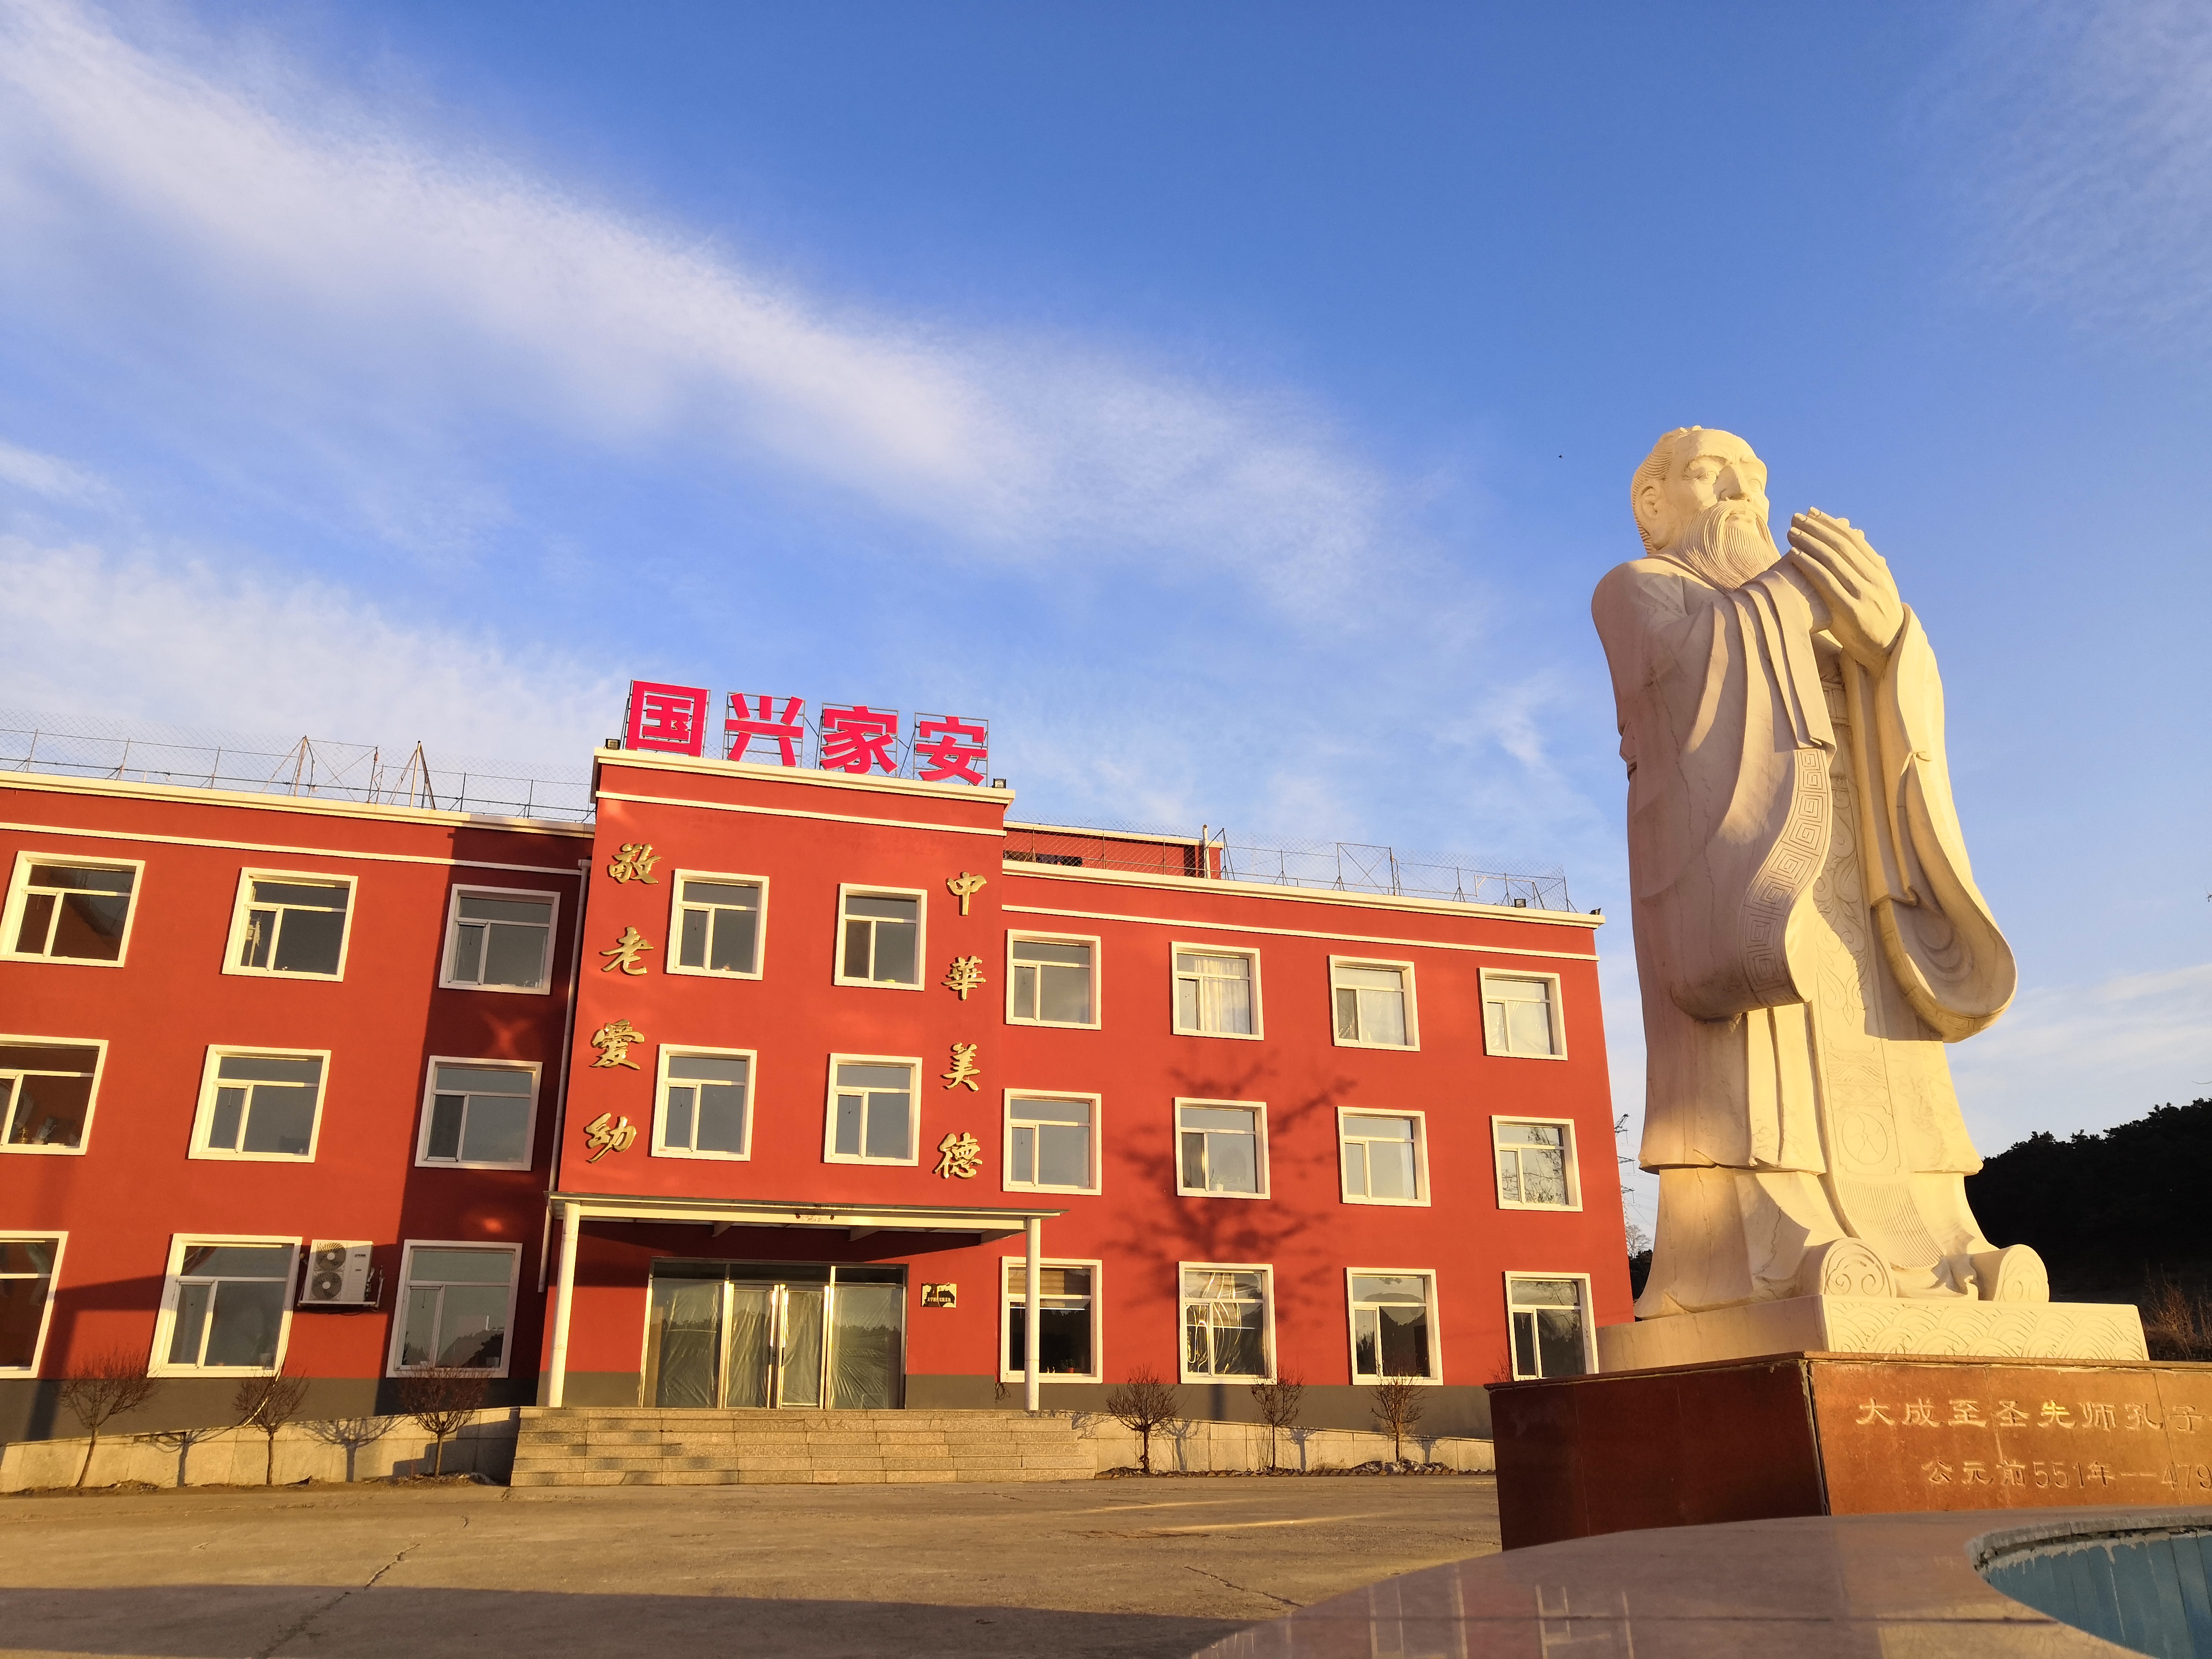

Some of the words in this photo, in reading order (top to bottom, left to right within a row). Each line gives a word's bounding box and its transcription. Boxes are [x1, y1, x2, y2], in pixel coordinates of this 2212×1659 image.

[625, 680, 988, 786] 国兴家安
[1855, 1397, 2205, 1434] 大成至圣先师孔子
